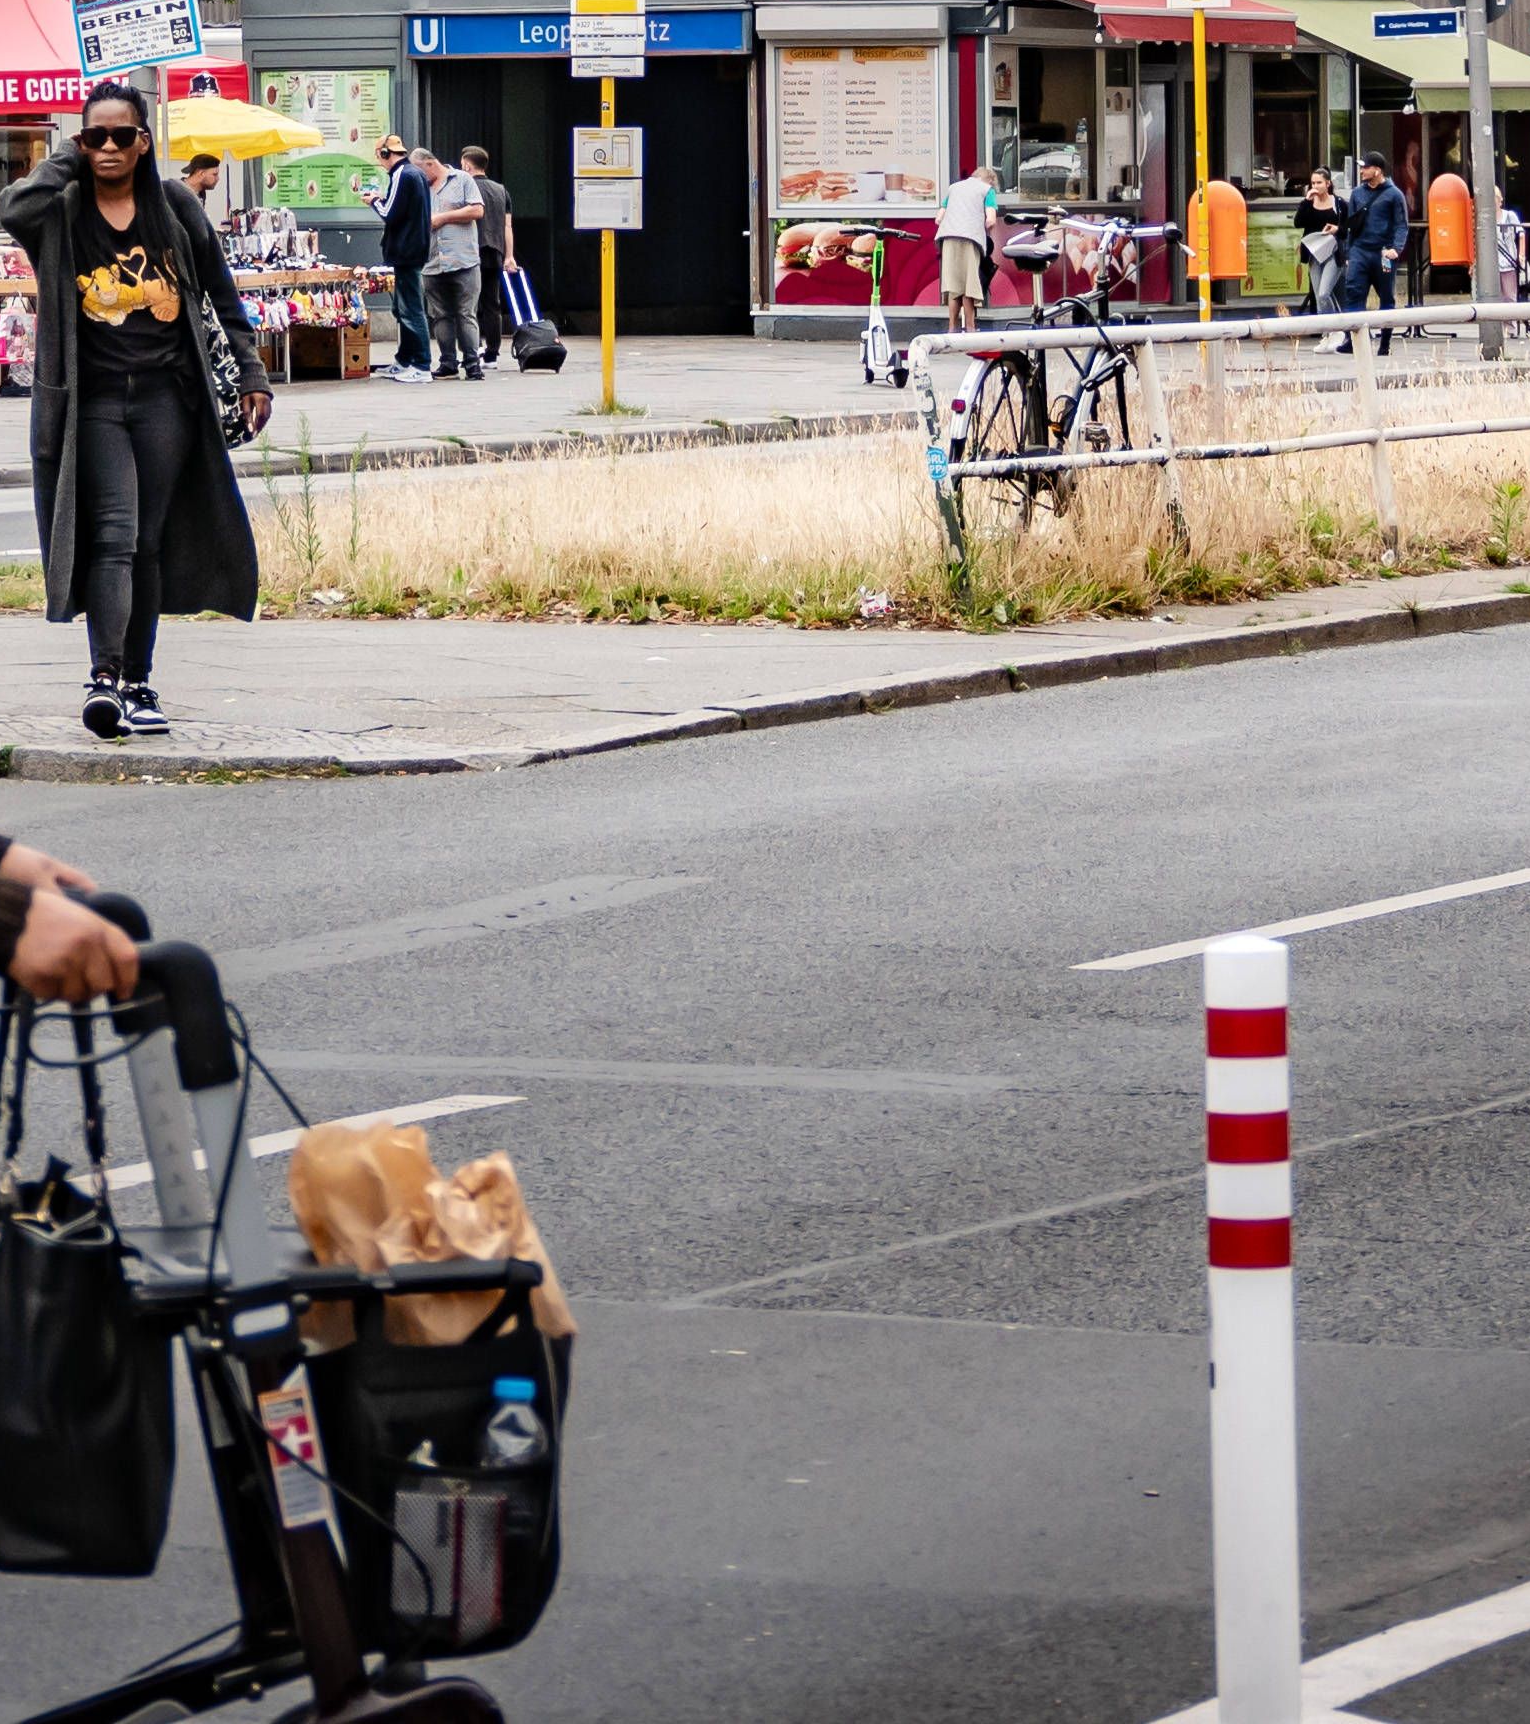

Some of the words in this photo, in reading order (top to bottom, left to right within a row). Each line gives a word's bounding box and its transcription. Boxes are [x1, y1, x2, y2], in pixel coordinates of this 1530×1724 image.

[81, 0, 186, 31] BERLIN
[173, 28, 191, 40] 30.
[413, 18, 439, 53] U
[520, 20, 670, 49] Leoptz
[25, 77, 103, 102] COFFE
